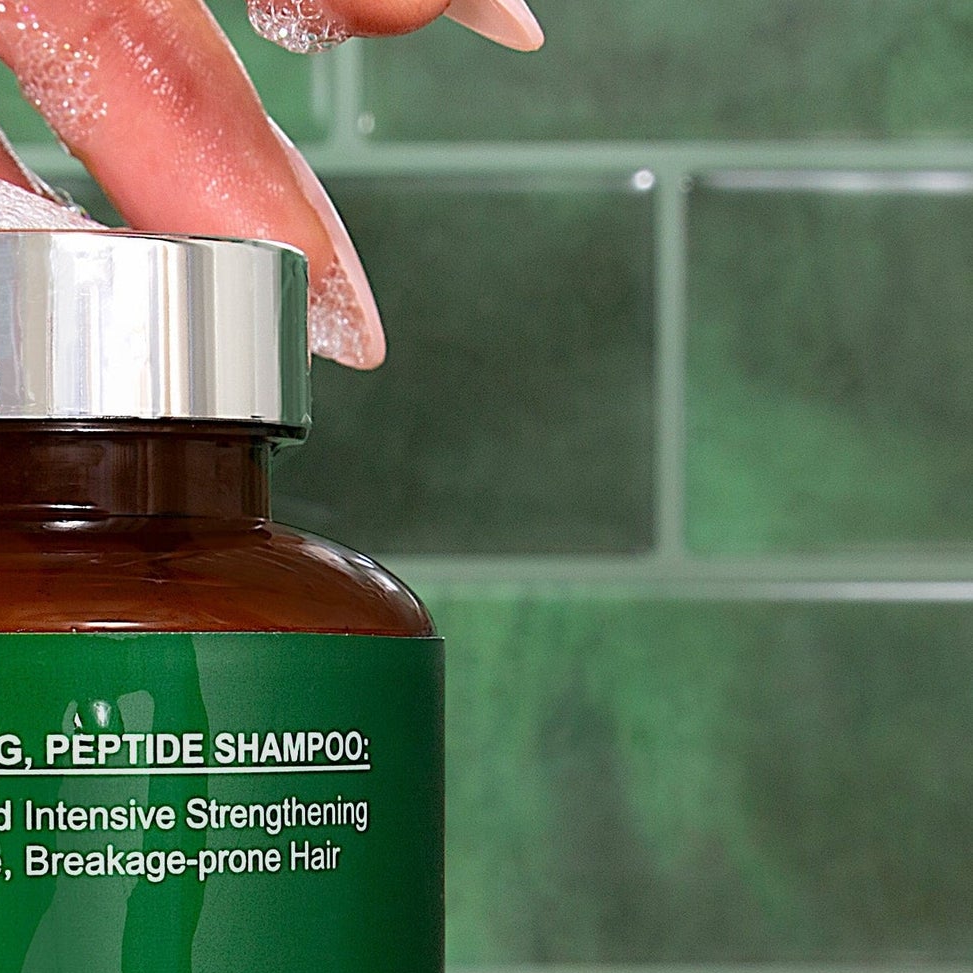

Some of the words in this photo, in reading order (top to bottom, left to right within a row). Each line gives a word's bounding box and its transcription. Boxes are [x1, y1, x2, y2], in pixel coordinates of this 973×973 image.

[46, 733, 204, 765] PEPTIDE
[214, 732, 370, 763] SHAMPOO:
[26, 799, 176, 831] Intensive
[186, 796, 368, 834] Strengthening
[26, 845, 282, 882] Breakage-prone
[290, 840, 341, 872] Hair
